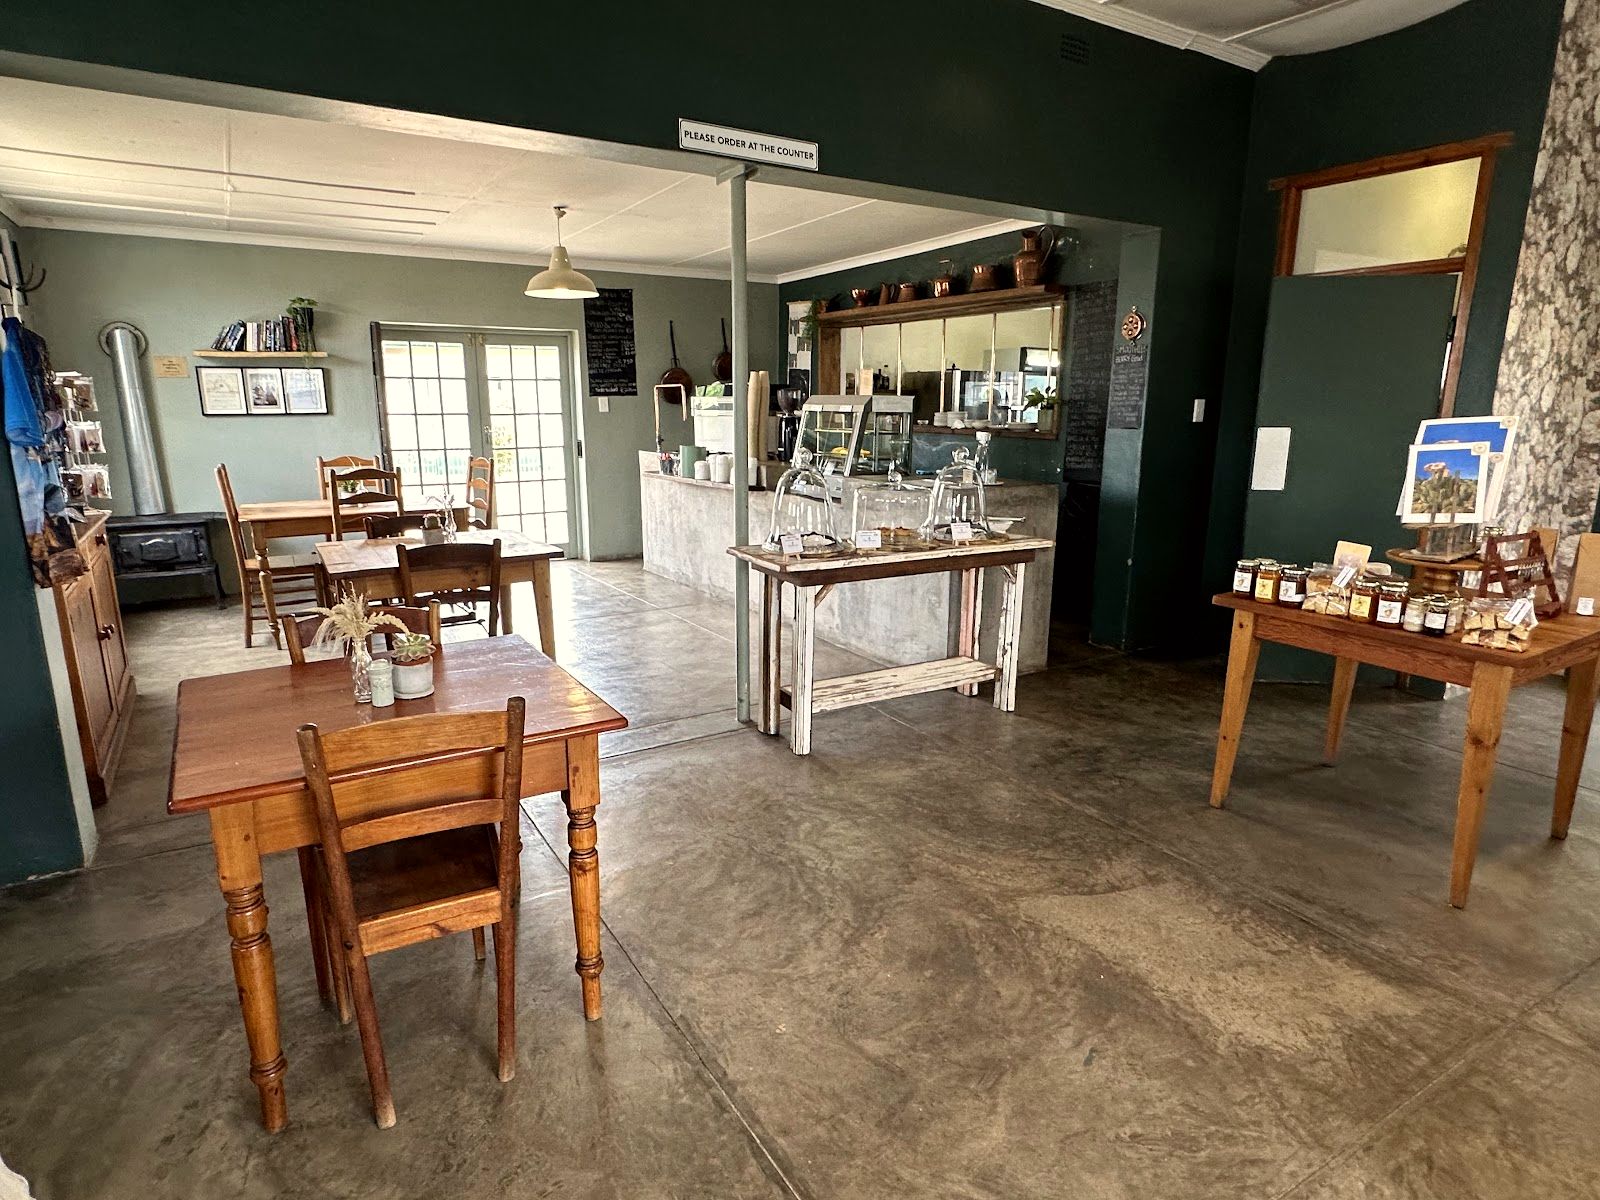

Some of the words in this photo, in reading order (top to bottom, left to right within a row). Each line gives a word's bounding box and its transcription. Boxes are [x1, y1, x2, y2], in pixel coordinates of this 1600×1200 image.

[684, 130, 715, 143] PLEASE
[717, 136, 746, 148] ORDER
[748, 142, 757, 151] AT
[760, 143, 775, 153] THE
[777, 147, 814, 160] COUNTER
